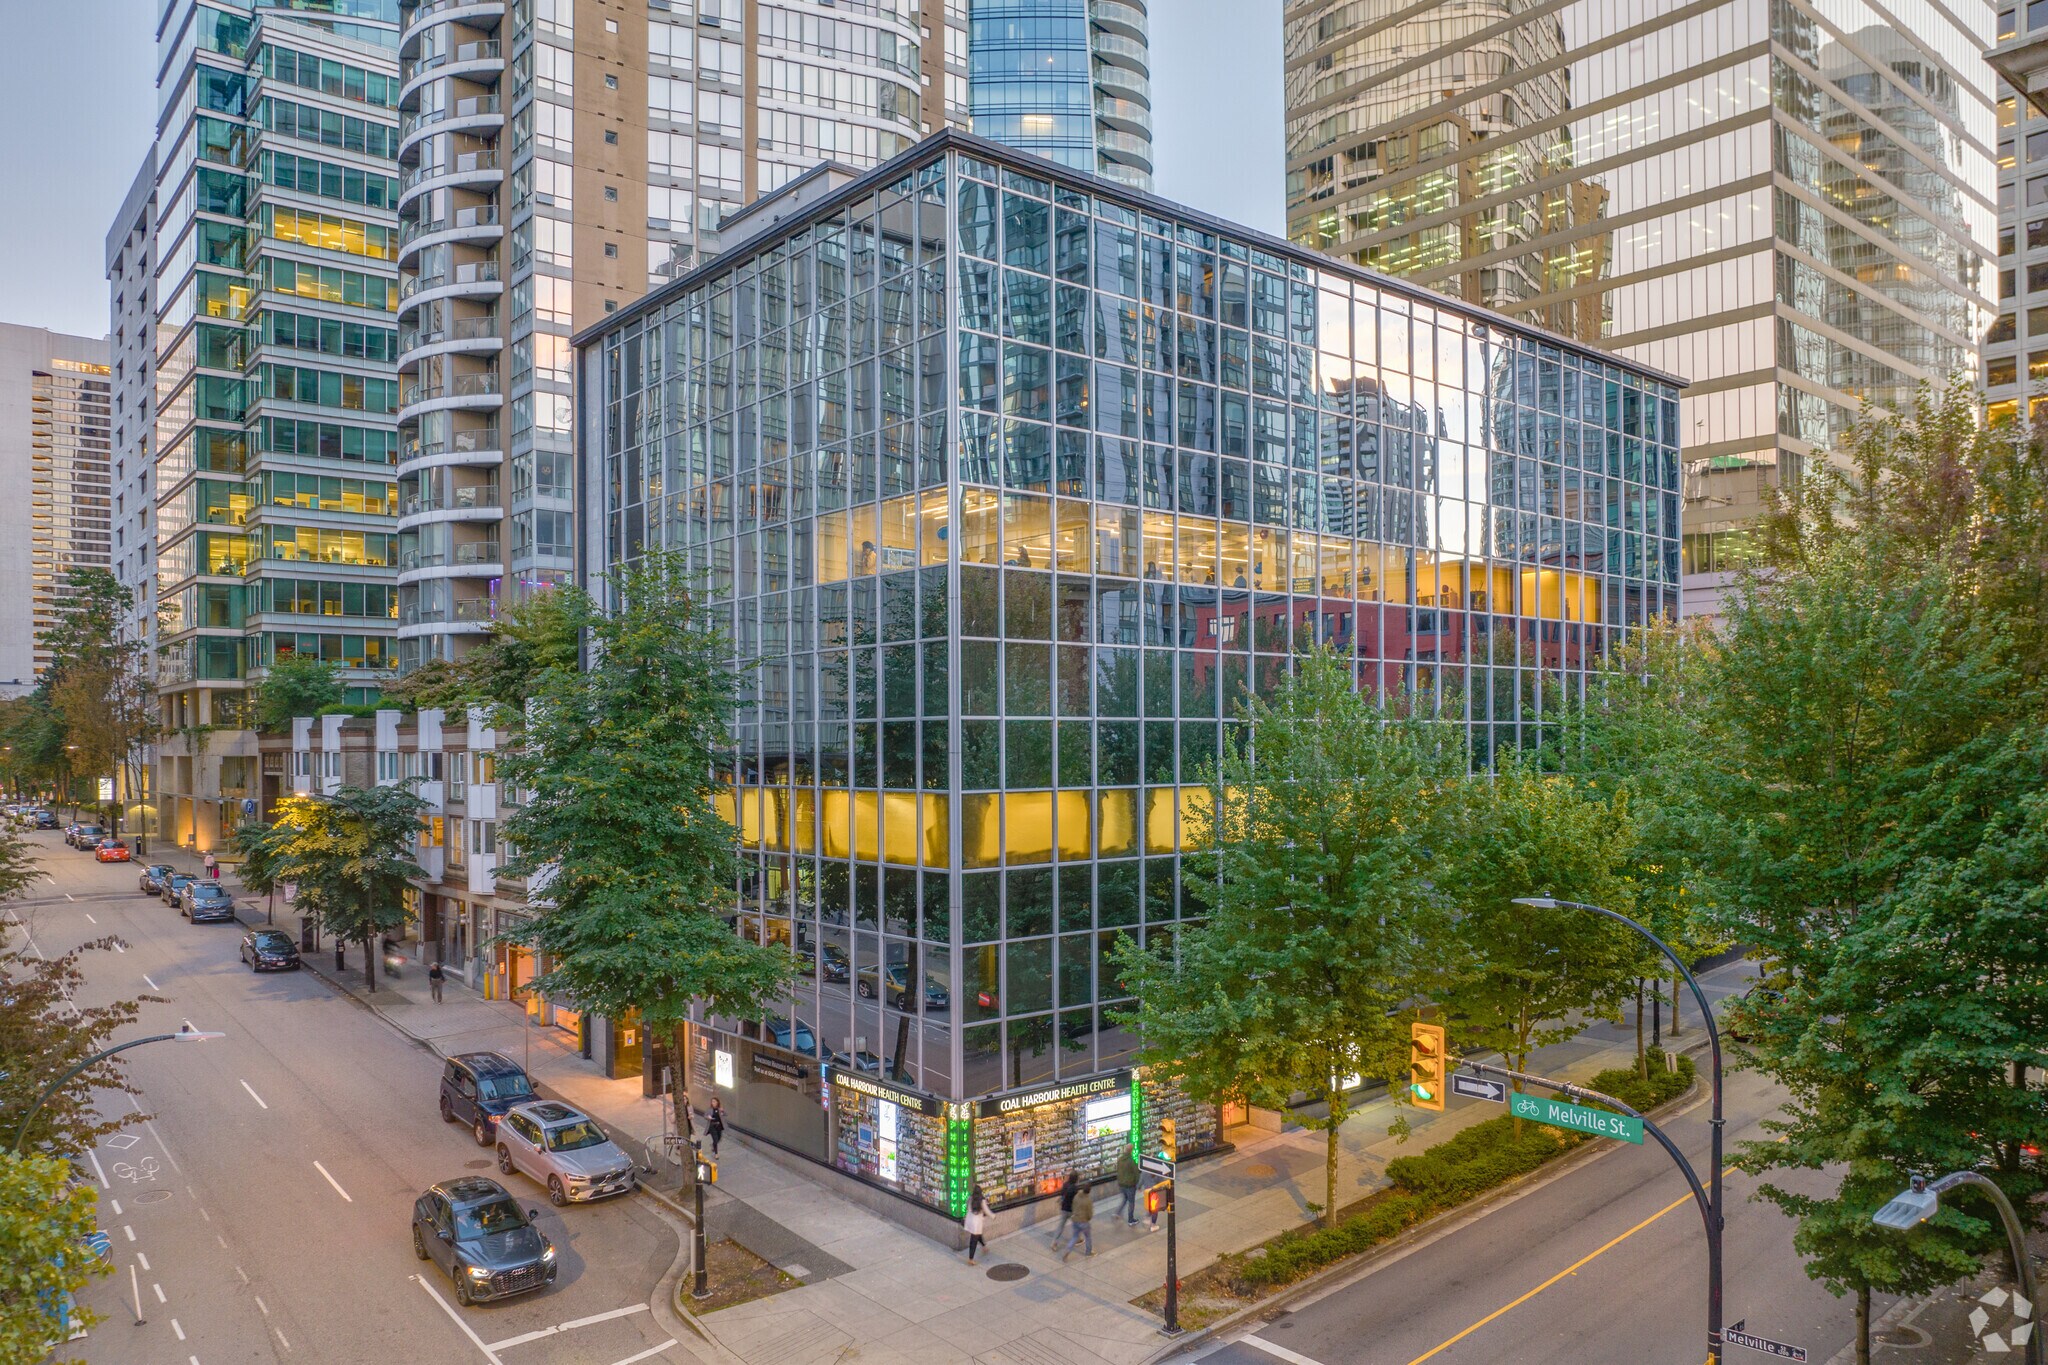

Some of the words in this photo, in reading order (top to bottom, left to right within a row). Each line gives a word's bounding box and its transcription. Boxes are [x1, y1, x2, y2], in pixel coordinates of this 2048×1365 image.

[836, 1074, 850, 1087] COAL
[850, 1077, 878, 1096] HARBOUR
[878, 1086, 900, 1103] HEALTH
[900, 1094, 922, 1110] CENTRE
[1000, 1097, 1020, 1111] COAL
[1022, 1089, 1060, 1107] HARBOUR
[1061, 1083, 1088, 1098] HEALTH
[1089, 1078, 1116, 1092] CENTRE
[1548, 1104, 1606, 1131] Melville
[1609, 1117, 1631, 1137] St.
[1728, 1331, 1775, 1353] Melville
